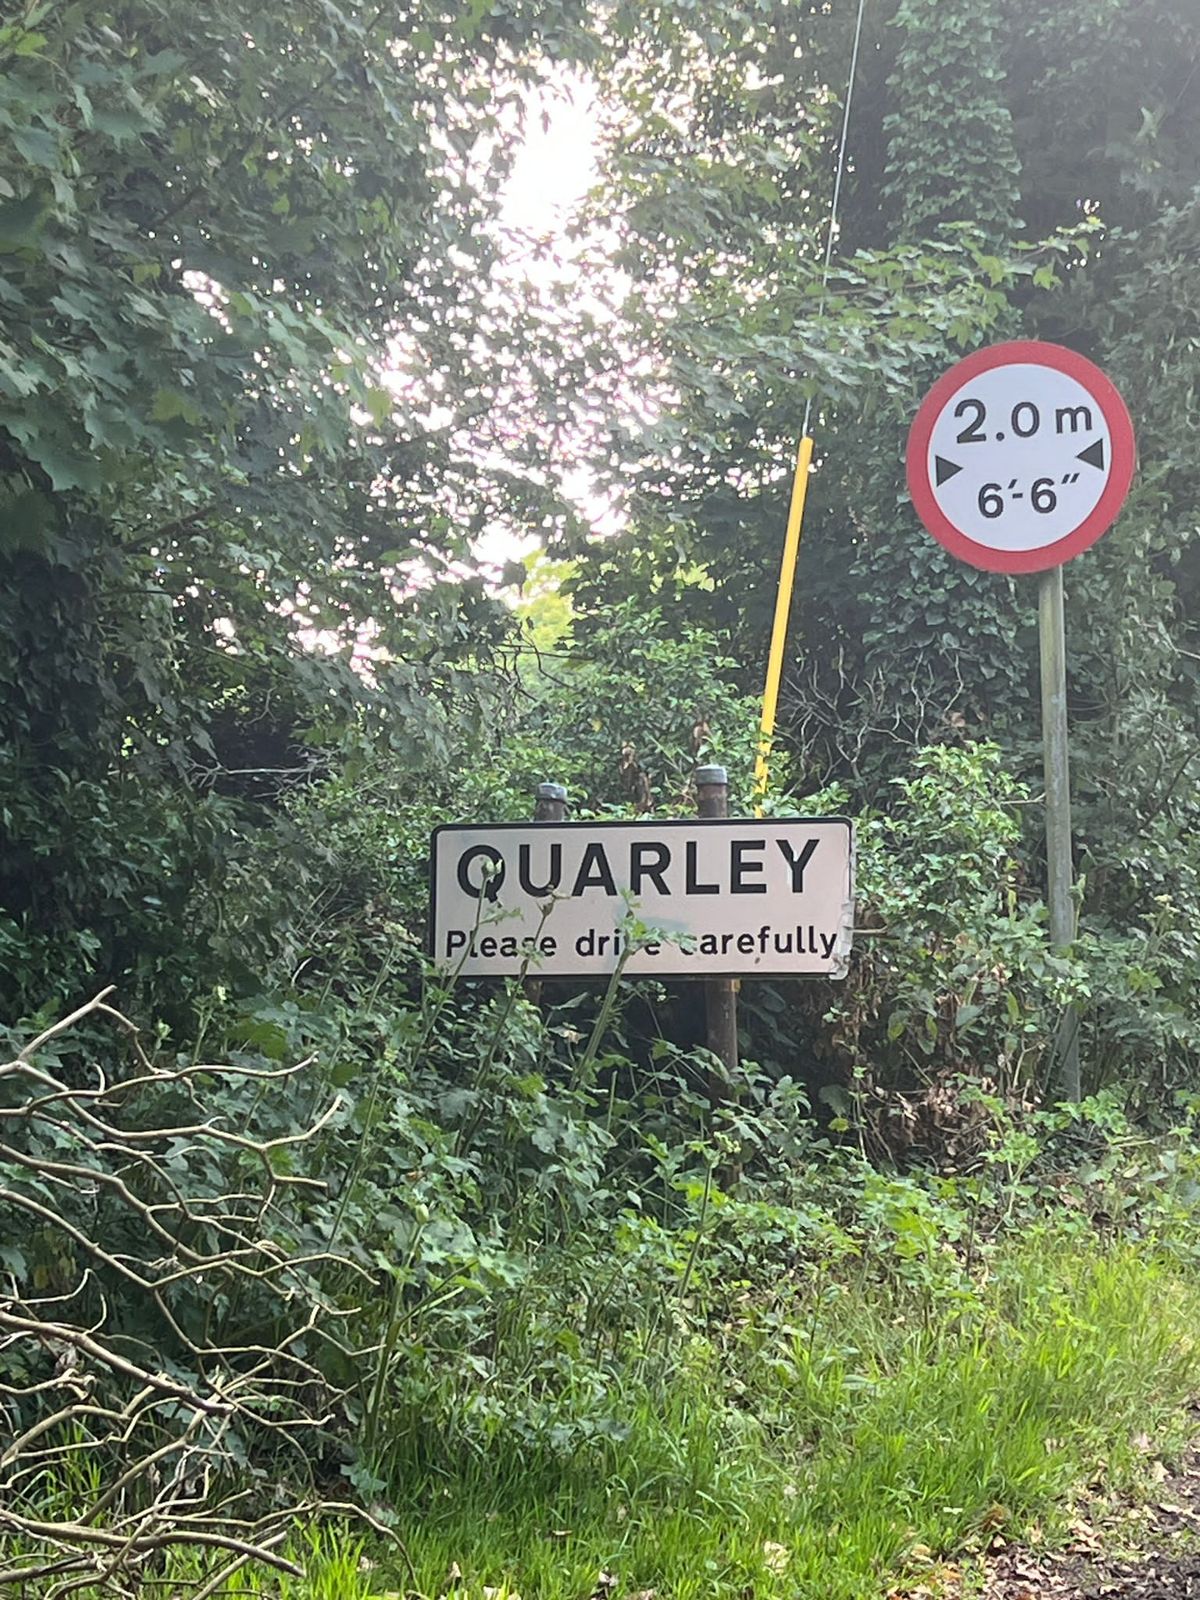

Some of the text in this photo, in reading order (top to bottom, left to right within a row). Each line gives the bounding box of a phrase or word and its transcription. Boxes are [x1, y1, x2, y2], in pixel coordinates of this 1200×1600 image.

[954, 398, 1093, 444] 2.0 m
[457, 838, 821, 903] QUARLEY
[575, 928, 661, 957] drie
